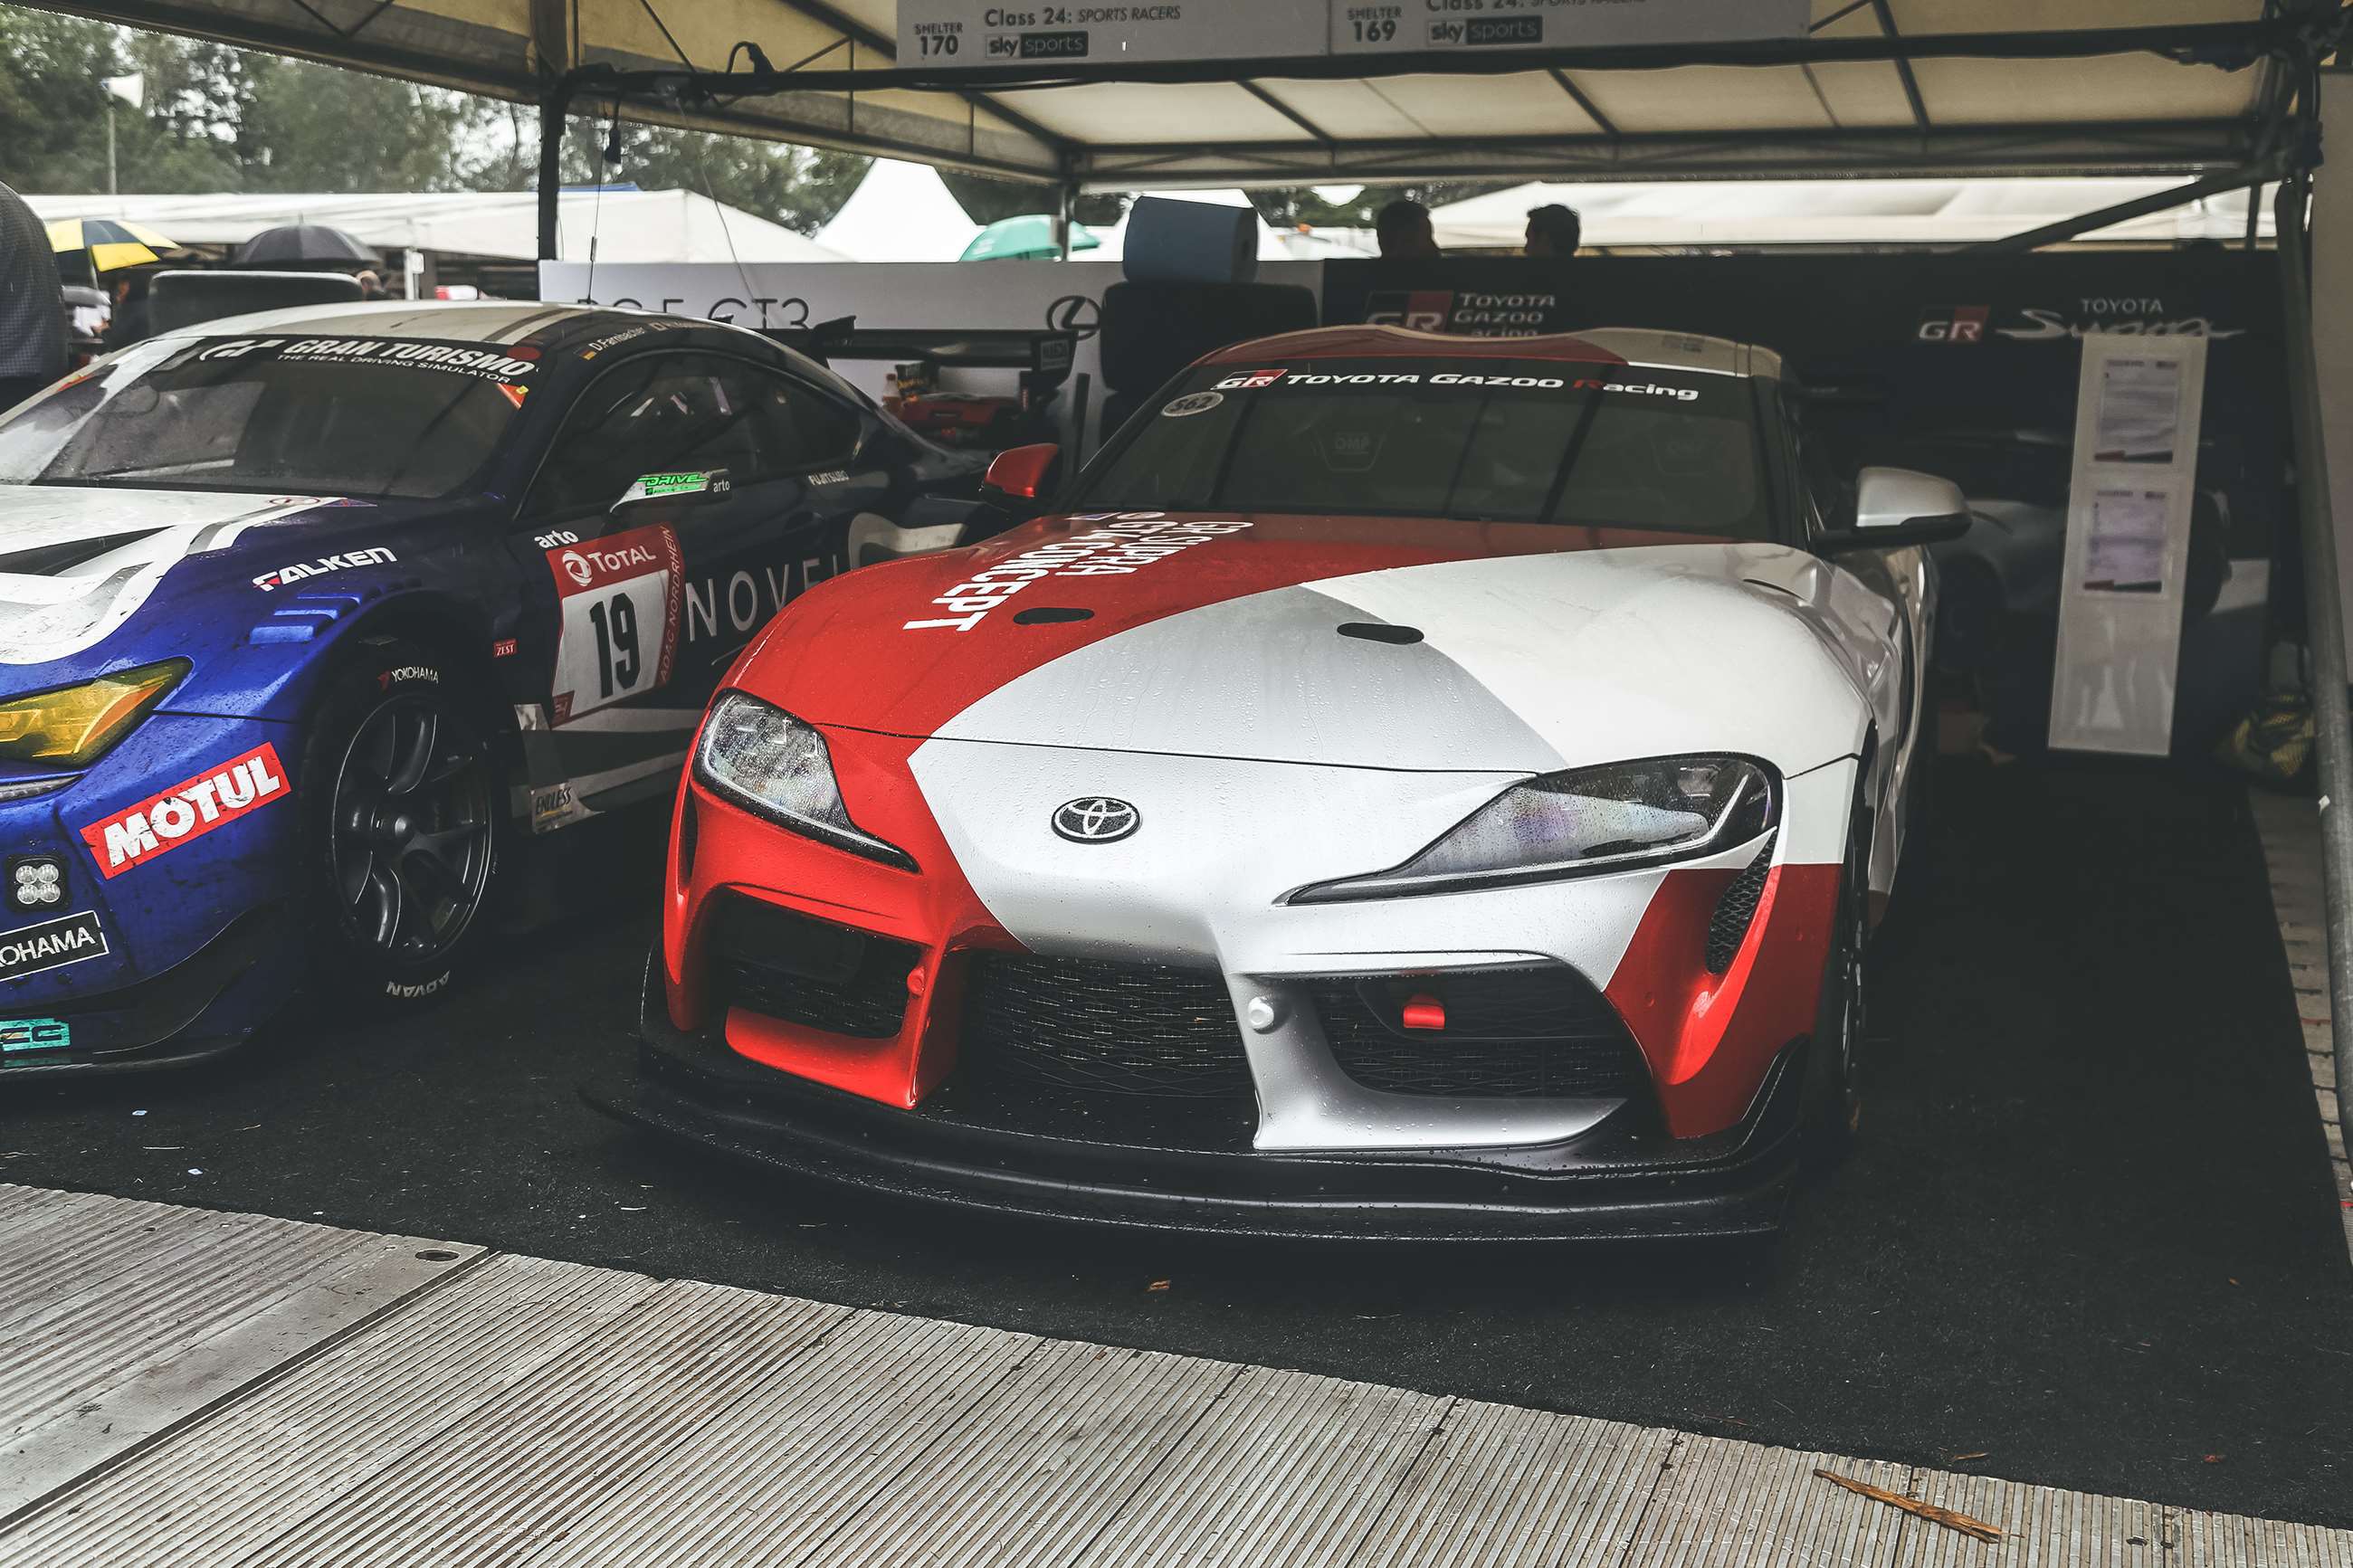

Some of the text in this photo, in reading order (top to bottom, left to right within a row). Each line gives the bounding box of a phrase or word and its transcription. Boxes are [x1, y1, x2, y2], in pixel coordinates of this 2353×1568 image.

[985, 5, 1181, 27] Class 24: SPORTS RACERS
[1347, 6, 1403, 21] SHELTER
[915, 23, 963, 34] SHELTER
[1354, 20, 1396, 43] 169
[1430, 20, 1537, 43] sky sports
[920, 35, 959, 55] 170
[987, 34, 1084, 58] sky sports
[1458, 292, 1557, 308] TOYOTA
[2082, 299, 2164, 314] TOYOTA
[1454, 309, 1544, 325] GAZOO
[1918, 321, 1982, 341] GR
[283, 339, 535, 376] GRAN TURISMO
[350, 356, 414, 367] DRIVING
[417, 362, 511, 384] SIMULATOR
[1216, 374, 1700, 401] GR TOYOTA GAZOO Racing
[713, 475, 730, 492] arto
[534, 529, 579, 549] arto
[1055, 521, 1254, 576] GR SUPRA
[252, 546, 398, 592] FALKEN
[587, 545, 657, 574] TOTAL
[902, 542, 1117, 632] CONCEPT
[589, 592, 642, 699] 19
[391, 666, 439, 684] YOKOHAMA
[103, 755, 281, 868] MOTUL
[0, 927, 96, 967] OHAMA
[386, 969, 451, 998] ADVAN
